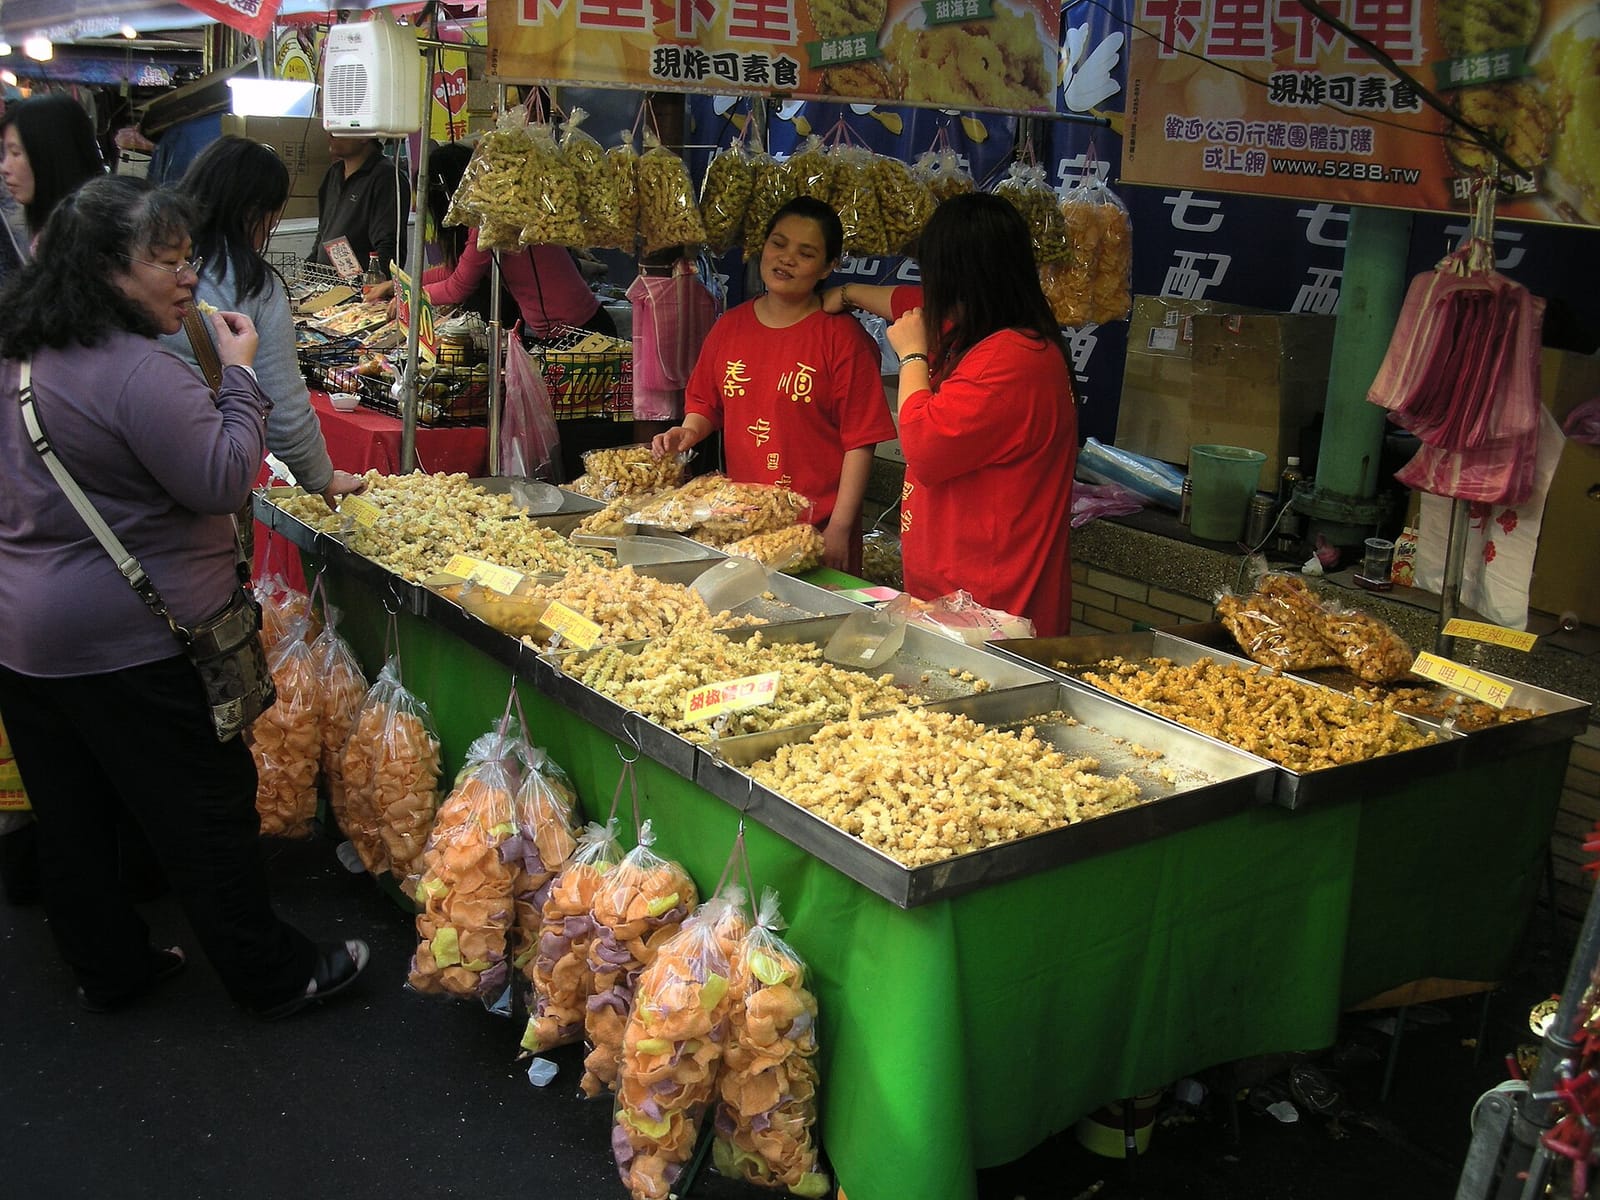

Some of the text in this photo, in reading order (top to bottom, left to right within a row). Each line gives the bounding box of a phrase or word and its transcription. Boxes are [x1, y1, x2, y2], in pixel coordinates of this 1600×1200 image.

[652, 47, 798, 86] 現炸可素食
[1269, 73, 1420, 109] 現炸可素食
[1165, 116, 1373, 153] 歡迎公司行號團體訂購
[1203, 148, 1267, 174] 或上網
